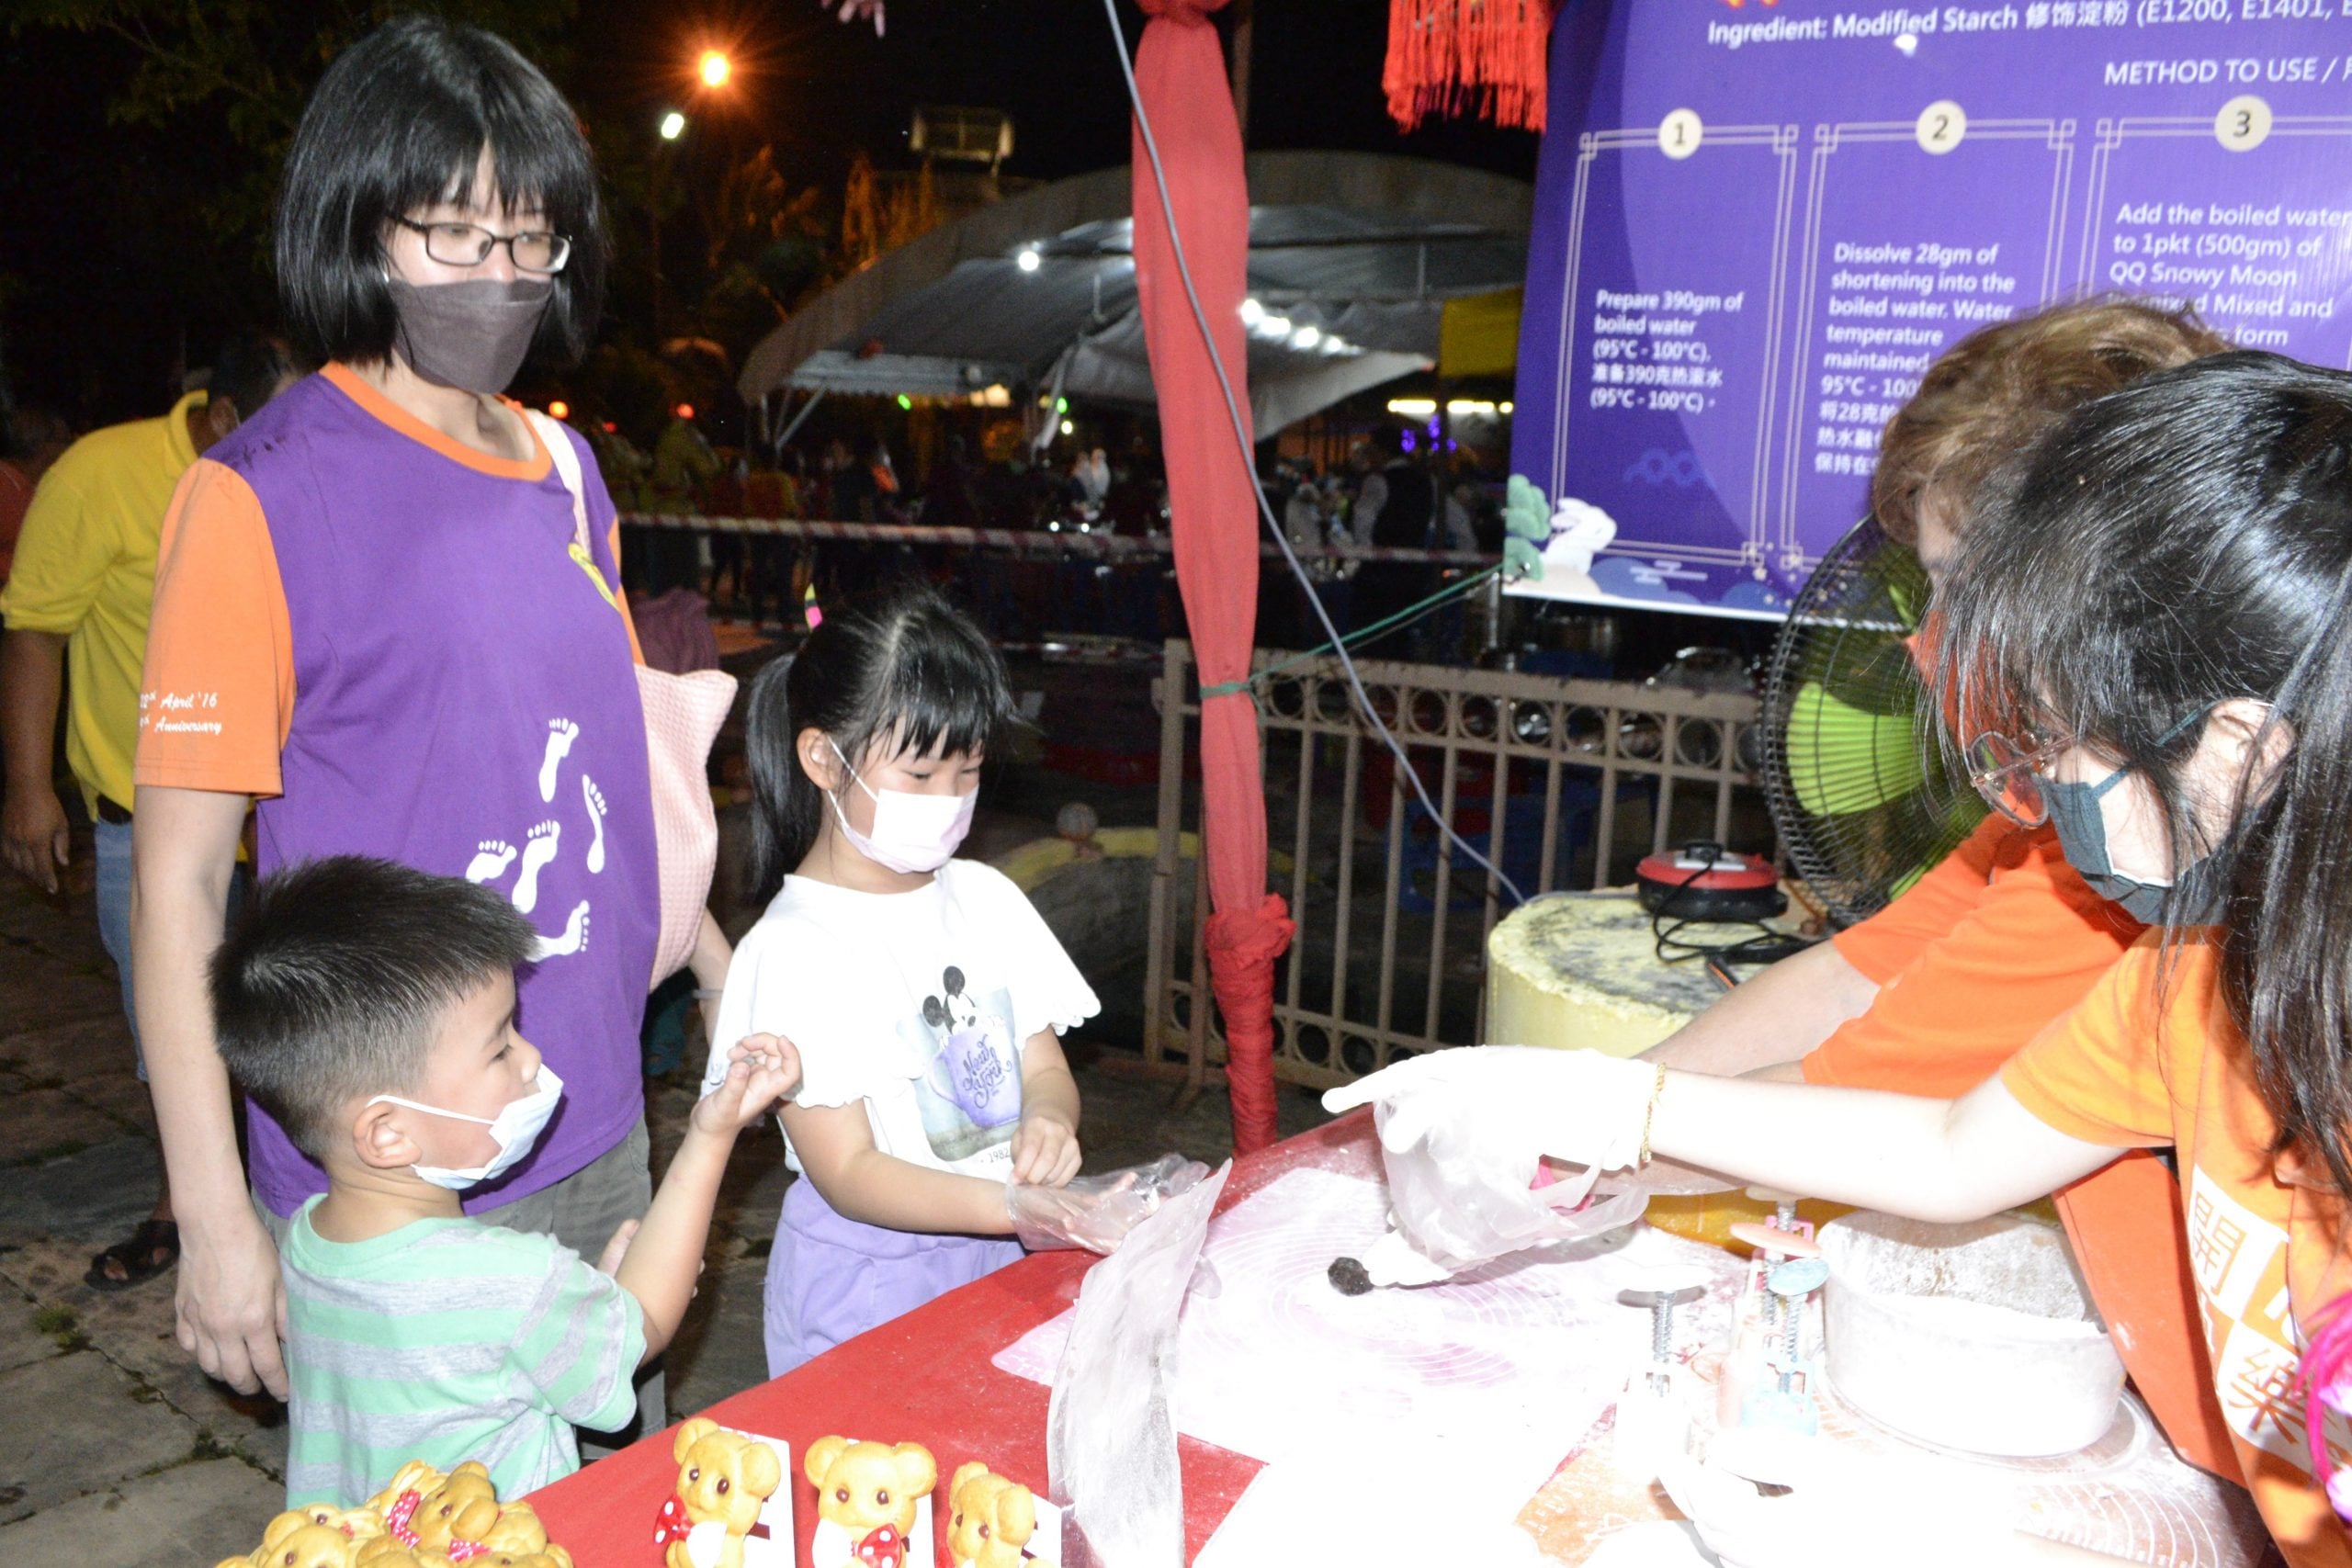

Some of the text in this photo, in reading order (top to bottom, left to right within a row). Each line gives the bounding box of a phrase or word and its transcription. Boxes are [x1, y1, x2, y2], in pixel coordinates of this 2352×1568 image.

[1708, 17, 1827, 49] Ingredient:
[1833, 8, 1939, 39] Modified
[1943, 5, 2018, 32] Starch
[2137, 0, 2233, 28] (E1200,
[2242, 0, 2334, 21] E1401,
[2104, 60, 2218, 85] METHOD
[2224, 59, 2260, 83] TO
[2267, 57, 2318, 83] USE
[1673, 123, 1687, 145] 1
[1931, 115, 1950, 140] 2
[2233, 109, 2251, 138] 3
[2116, 203, 2352, 229] Add the boiled water
[1833, 242, 2000, 268] Dissolve 28gm of
[2113, 232, 2323, 261] to 1pkt (500gm) of
[1830, 269, 2016, 297] shortening into the
[2109, 260, 2298, 289] QQ Snowy Moon
[1596, 288, 1745, 315] Prepare 390gm of
[1828, 296, 1889, 318] boiled
[1952, 299, 2014, 322] Water
[2212, 294, 2284, 317] Mixed
[2289, 297, 2334, 318] and
[1594, 312, 1698, 336] boiled water
[1826, 323, 1944, 348] temperature
[2234, 324, 2289, 346] form
[1823, 350, 1930, 372] maintained
[1820, 374, 1866, 396] 95°C
[1882, 377, 1923, 399] 100
[160, 692, 194, 711] April
[153, 716, 222, 735] Anniversary
[963, 1033, 989, 1090] New
[973, 1046, 1012, 1109] York
